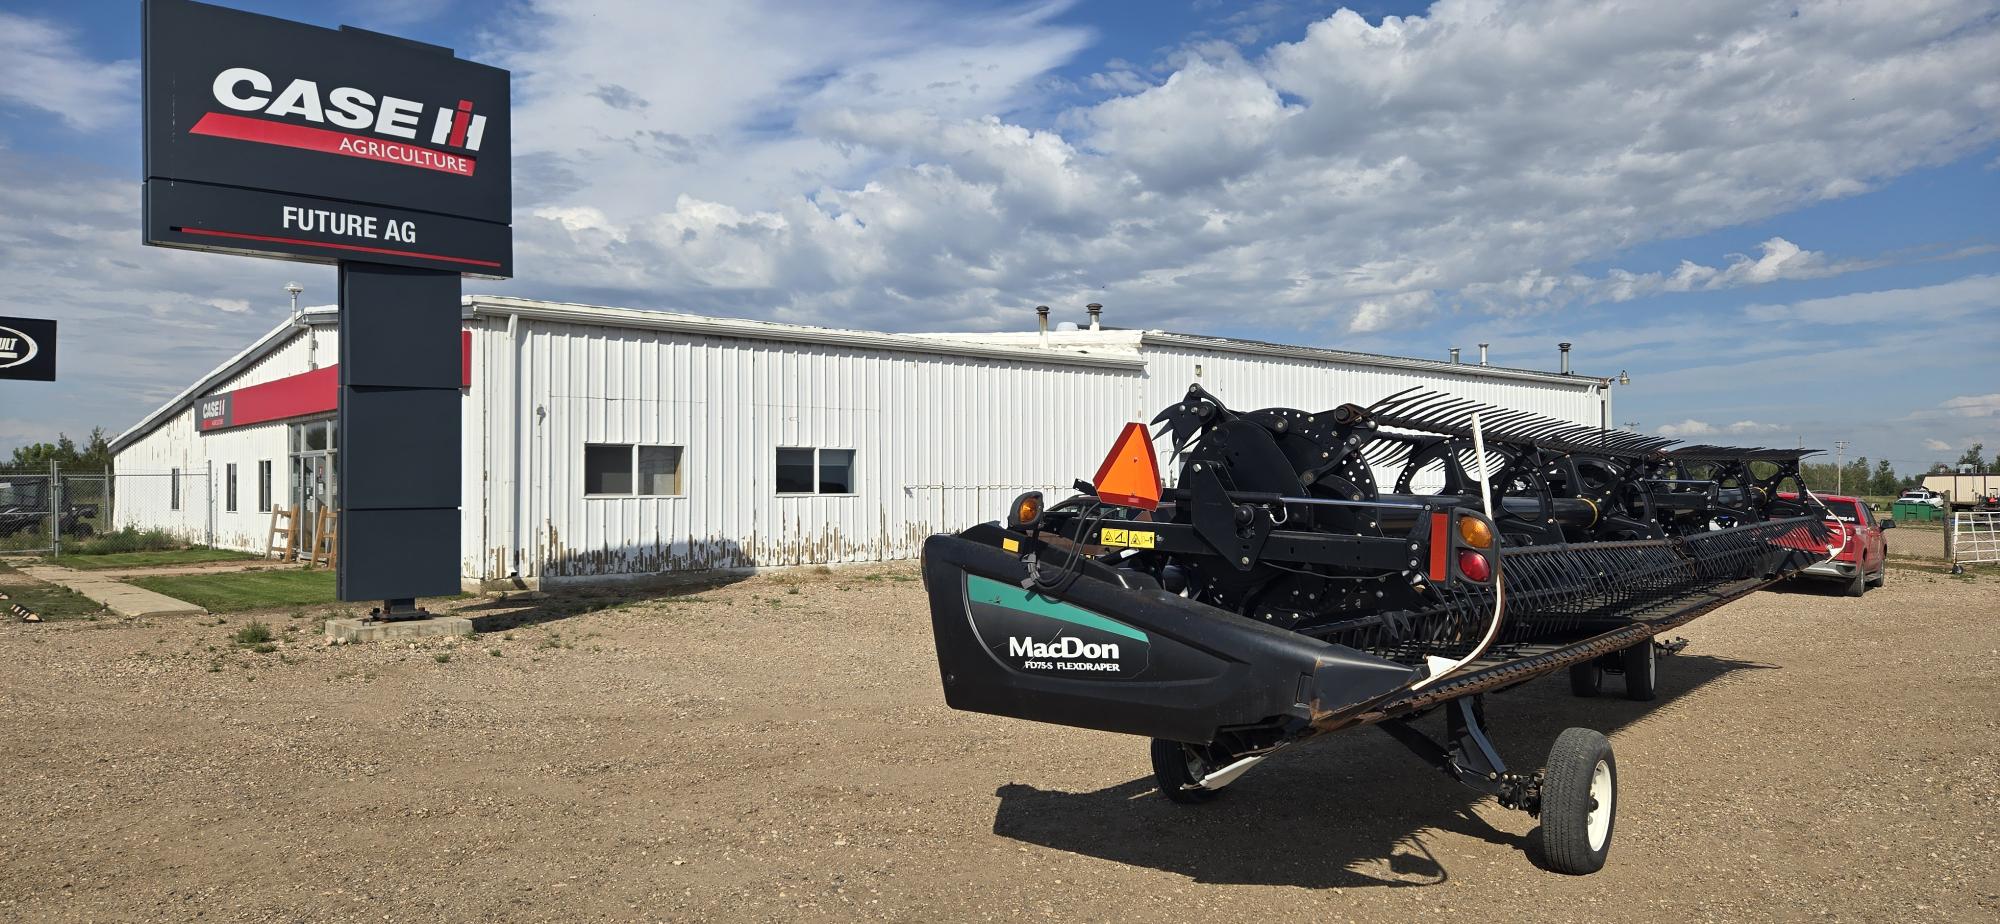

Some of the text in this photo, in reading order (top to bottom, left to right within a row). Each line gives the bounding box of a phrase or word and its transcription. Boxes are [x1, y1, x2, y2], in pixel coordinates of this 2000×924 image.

[212, 67, 424, 140] CASE
[338, 138, 468, 173] AGRICULTURE
[282, 205, 417, 244] FUTURE AG
[202, 400, 220, 419] CASE
[1009, 636, 1120, 660] MacDon
[1024, 661, 1121, 672] FD75-S FLEXDRAPER
